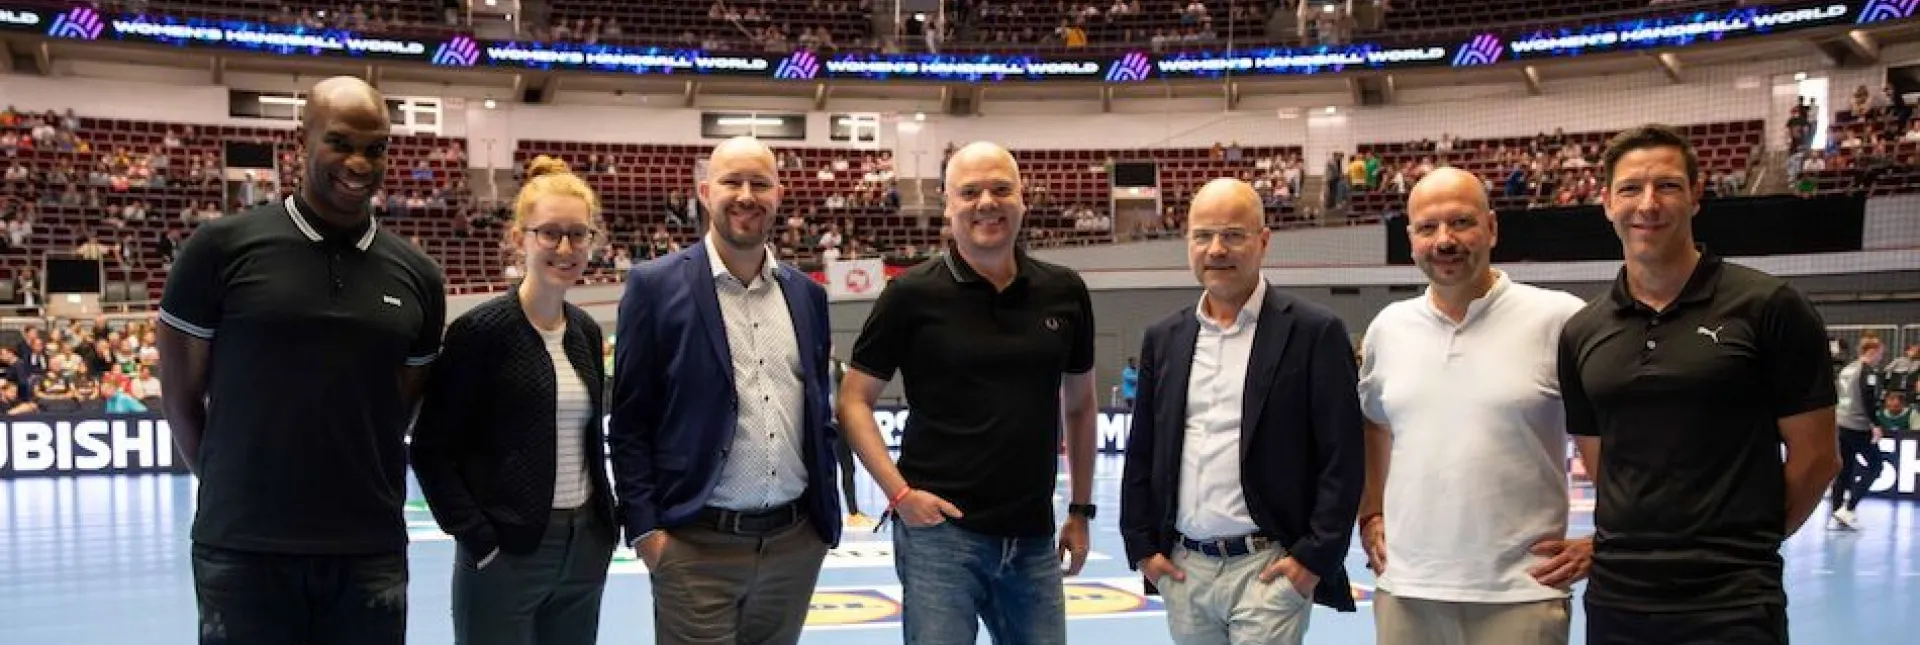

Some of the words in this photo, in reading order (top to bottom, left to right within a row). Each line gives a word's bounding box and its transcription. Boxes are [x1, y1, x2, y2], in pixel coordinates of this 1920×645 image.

[112, 20, 223, 40] WOMEN'S
[225, 30, 343, 48] HANDBALL
[346, 39, 425, 54] WORLD
[1511, 31, 1617, 53] WOMEN'S
[1621, 18, 1748, 42] HANDBALL
[1753, 4, 1847, 26] WORLD
[487, 47, 585, 63] WOMEN'S
[586, 53, 692, 67] HANDBALL
[695, 57, 768, 70] WORLD
[826, 61, 919, 73] WOMEN'S
[921, 62, 1024, 74] HANDBALL
[1026, 62, 1099, 74] WORLD
[1158, 57, 1252, 71] WOMEN'S
[1255, 54, 1364, 68] HANDBALL
[1367, 47, 1446, 62] WORLD
[0, 420, 173, 471] BISHI
